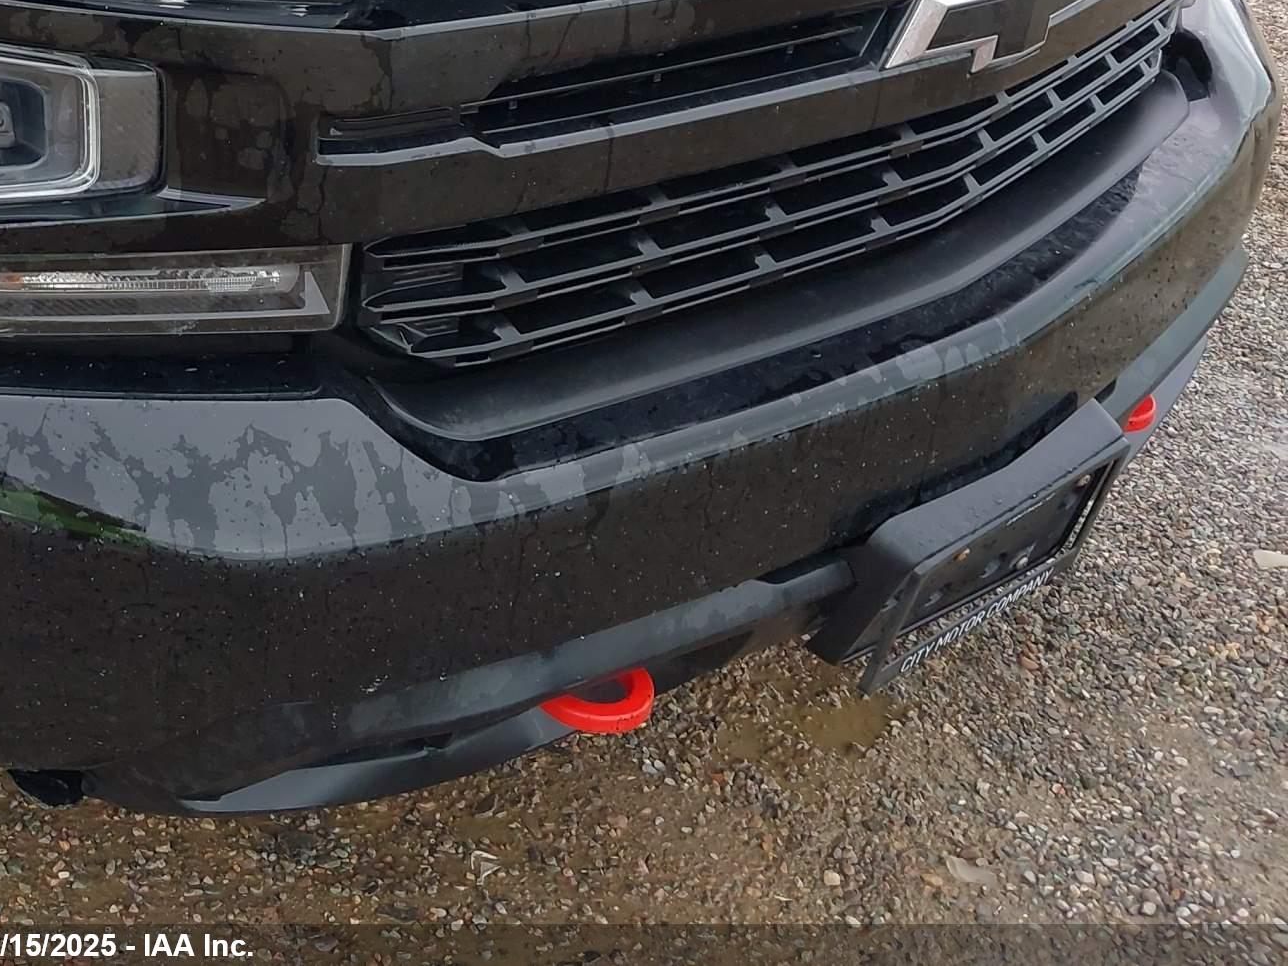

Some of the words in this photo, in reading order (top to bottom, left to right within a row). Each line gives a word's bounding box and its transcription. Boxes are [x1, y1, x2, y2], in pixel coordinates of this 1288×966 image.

[900, 641, 936, 673] CITY
[934, 611, 986, 651] MOTOR
[986, 567, 1055, 618] COMPANY
